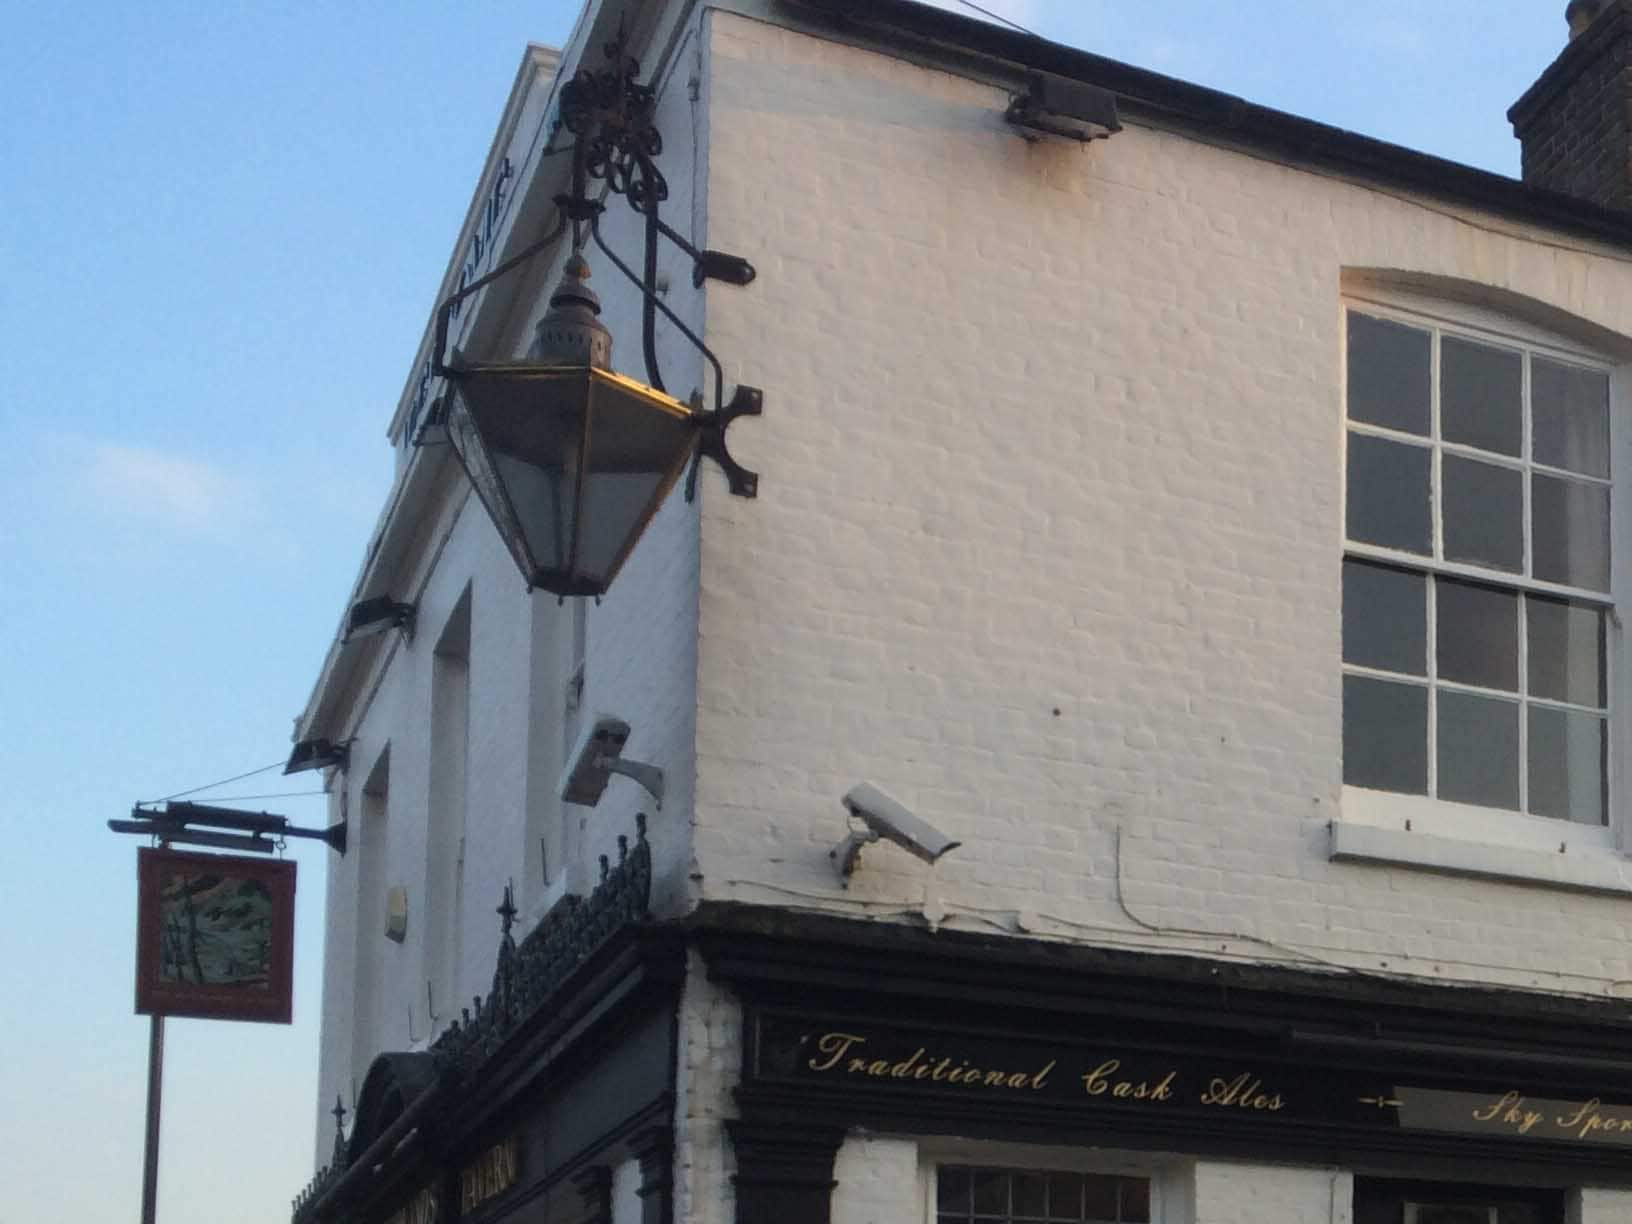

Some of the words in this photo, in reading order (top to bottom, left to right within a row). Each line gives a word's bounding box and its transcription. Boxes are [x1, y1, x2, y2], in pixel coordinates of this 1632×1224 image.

[808, 1033, 1057, 1090] Traditional
[1081, 1060, 1177, 1101] Cask
[1201, 1073, 1286, 1111] Ales
[1472, 1090, 1544, 1134] Sky
